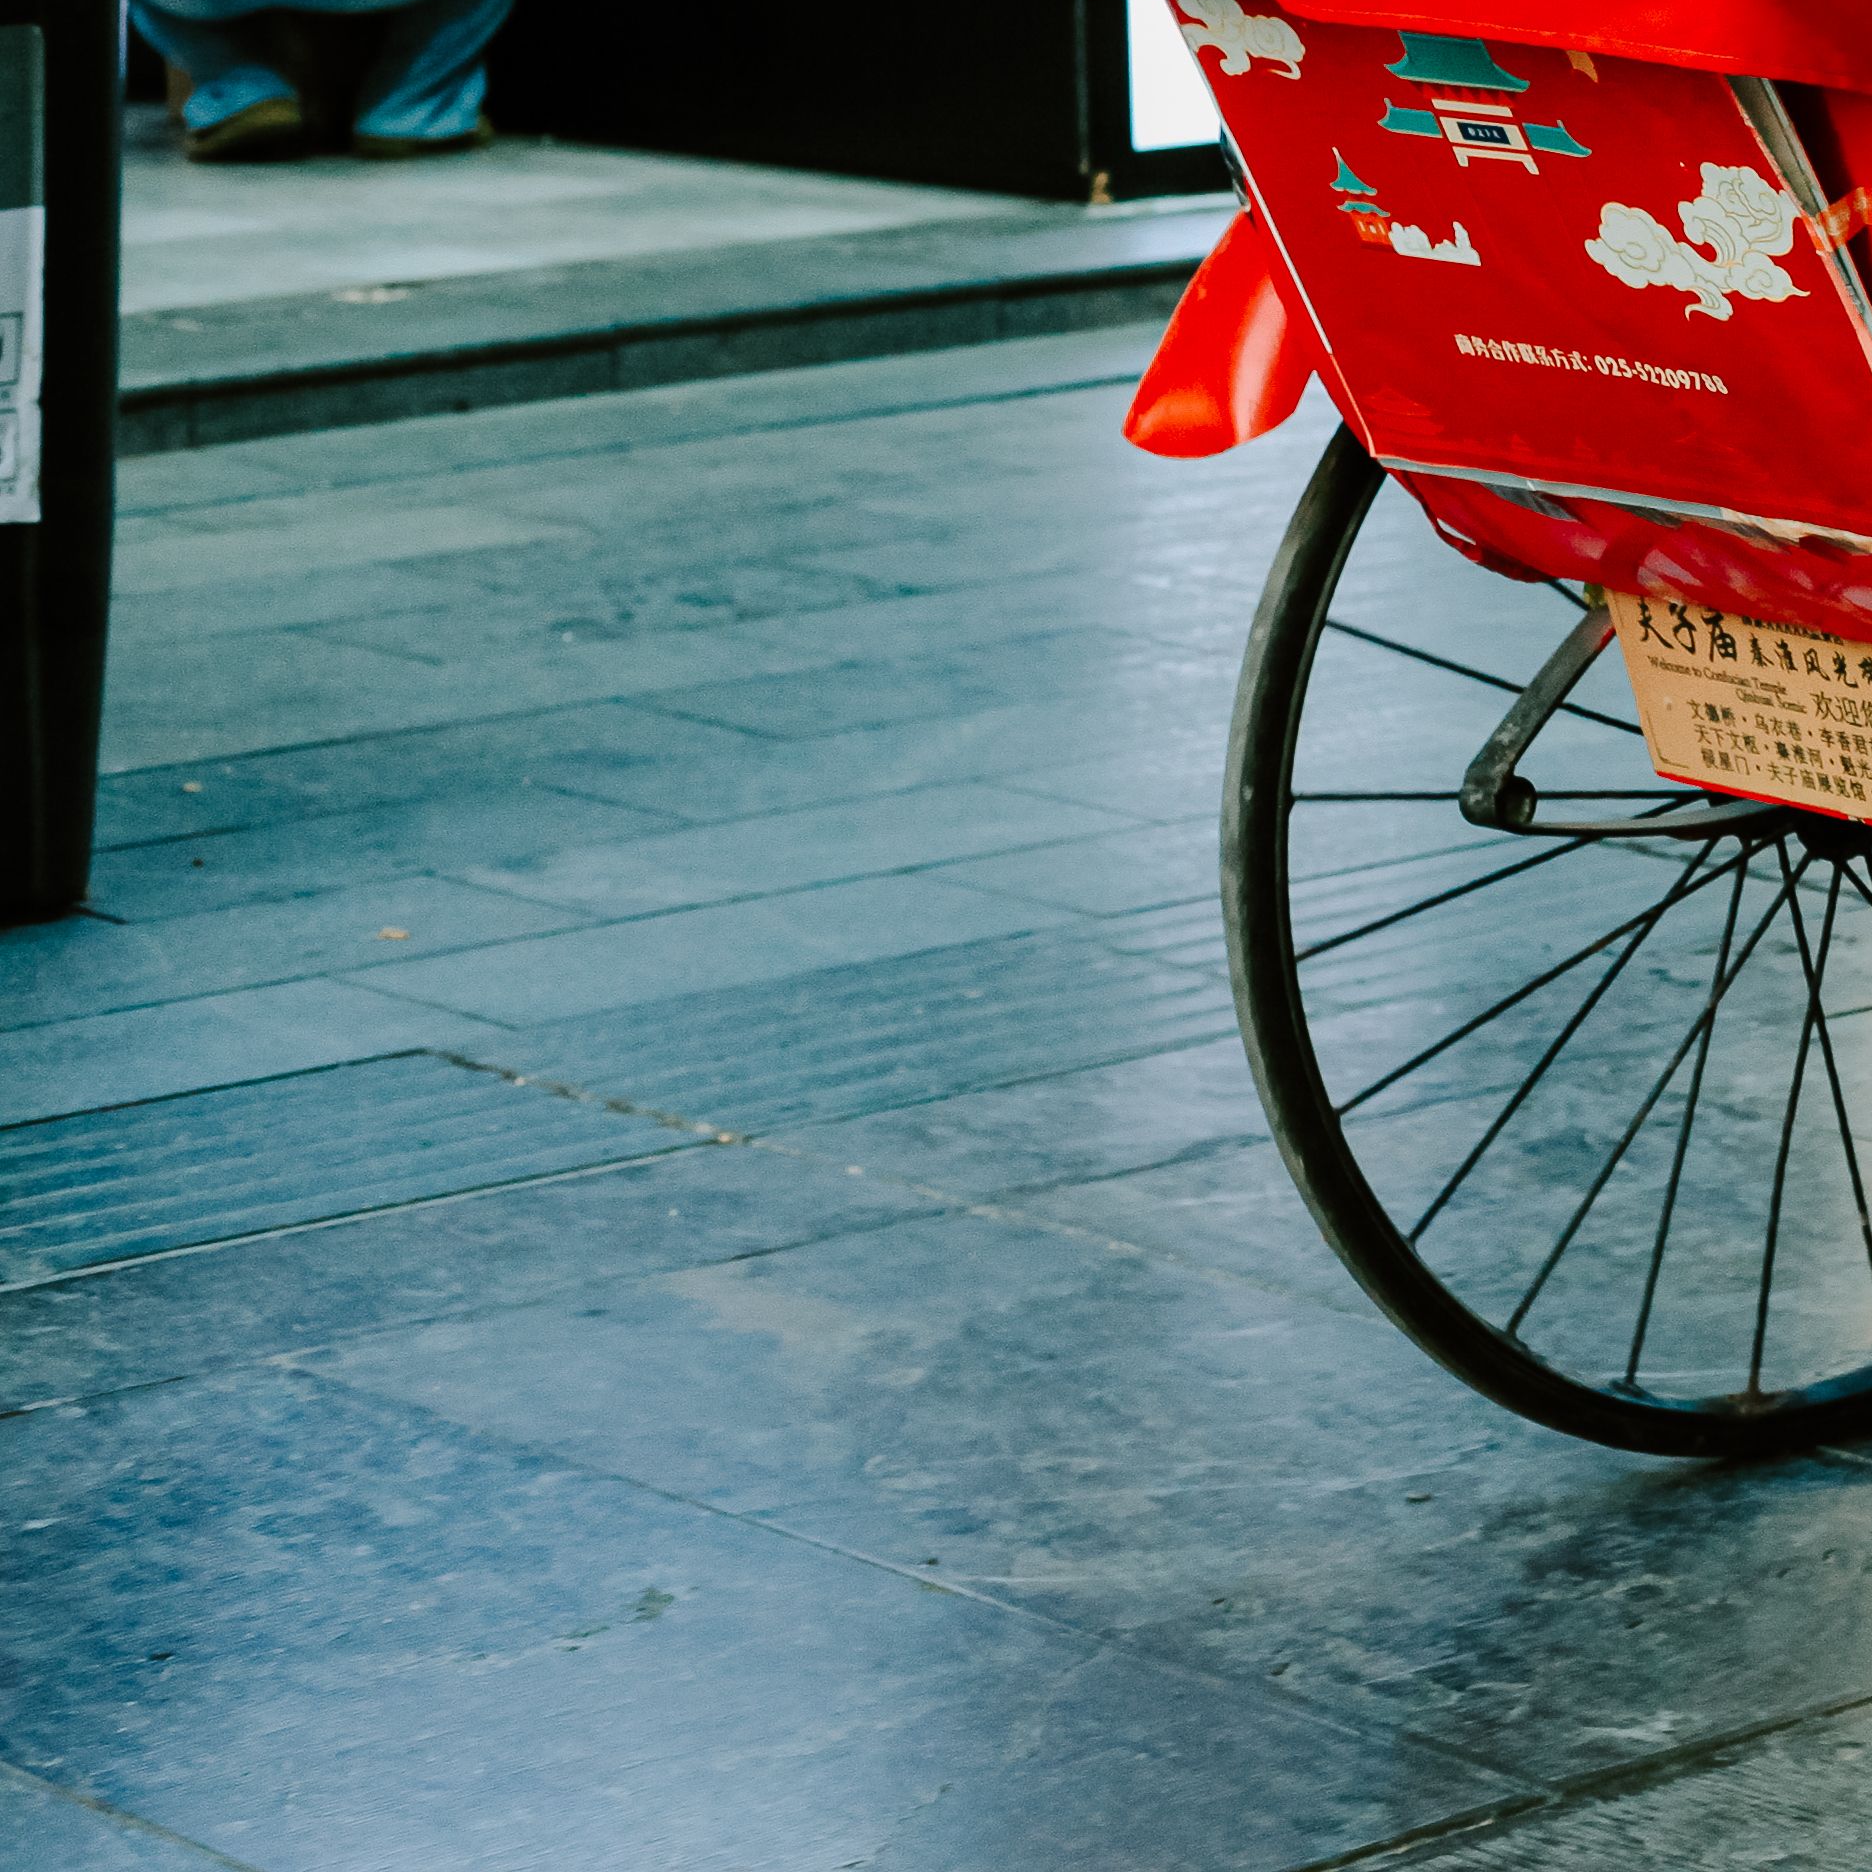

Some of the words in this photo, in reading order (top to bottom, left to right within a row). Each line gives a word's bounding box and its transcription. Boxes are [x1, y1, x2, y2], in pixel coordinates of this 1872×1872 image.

[1594, 354, 1729, 396] 025-52209788
[1637, 596, 1738, 664] 夫子庙
[1647, 655, 1692, 677] Welcome
[1692, 666, 1702, 678] to
